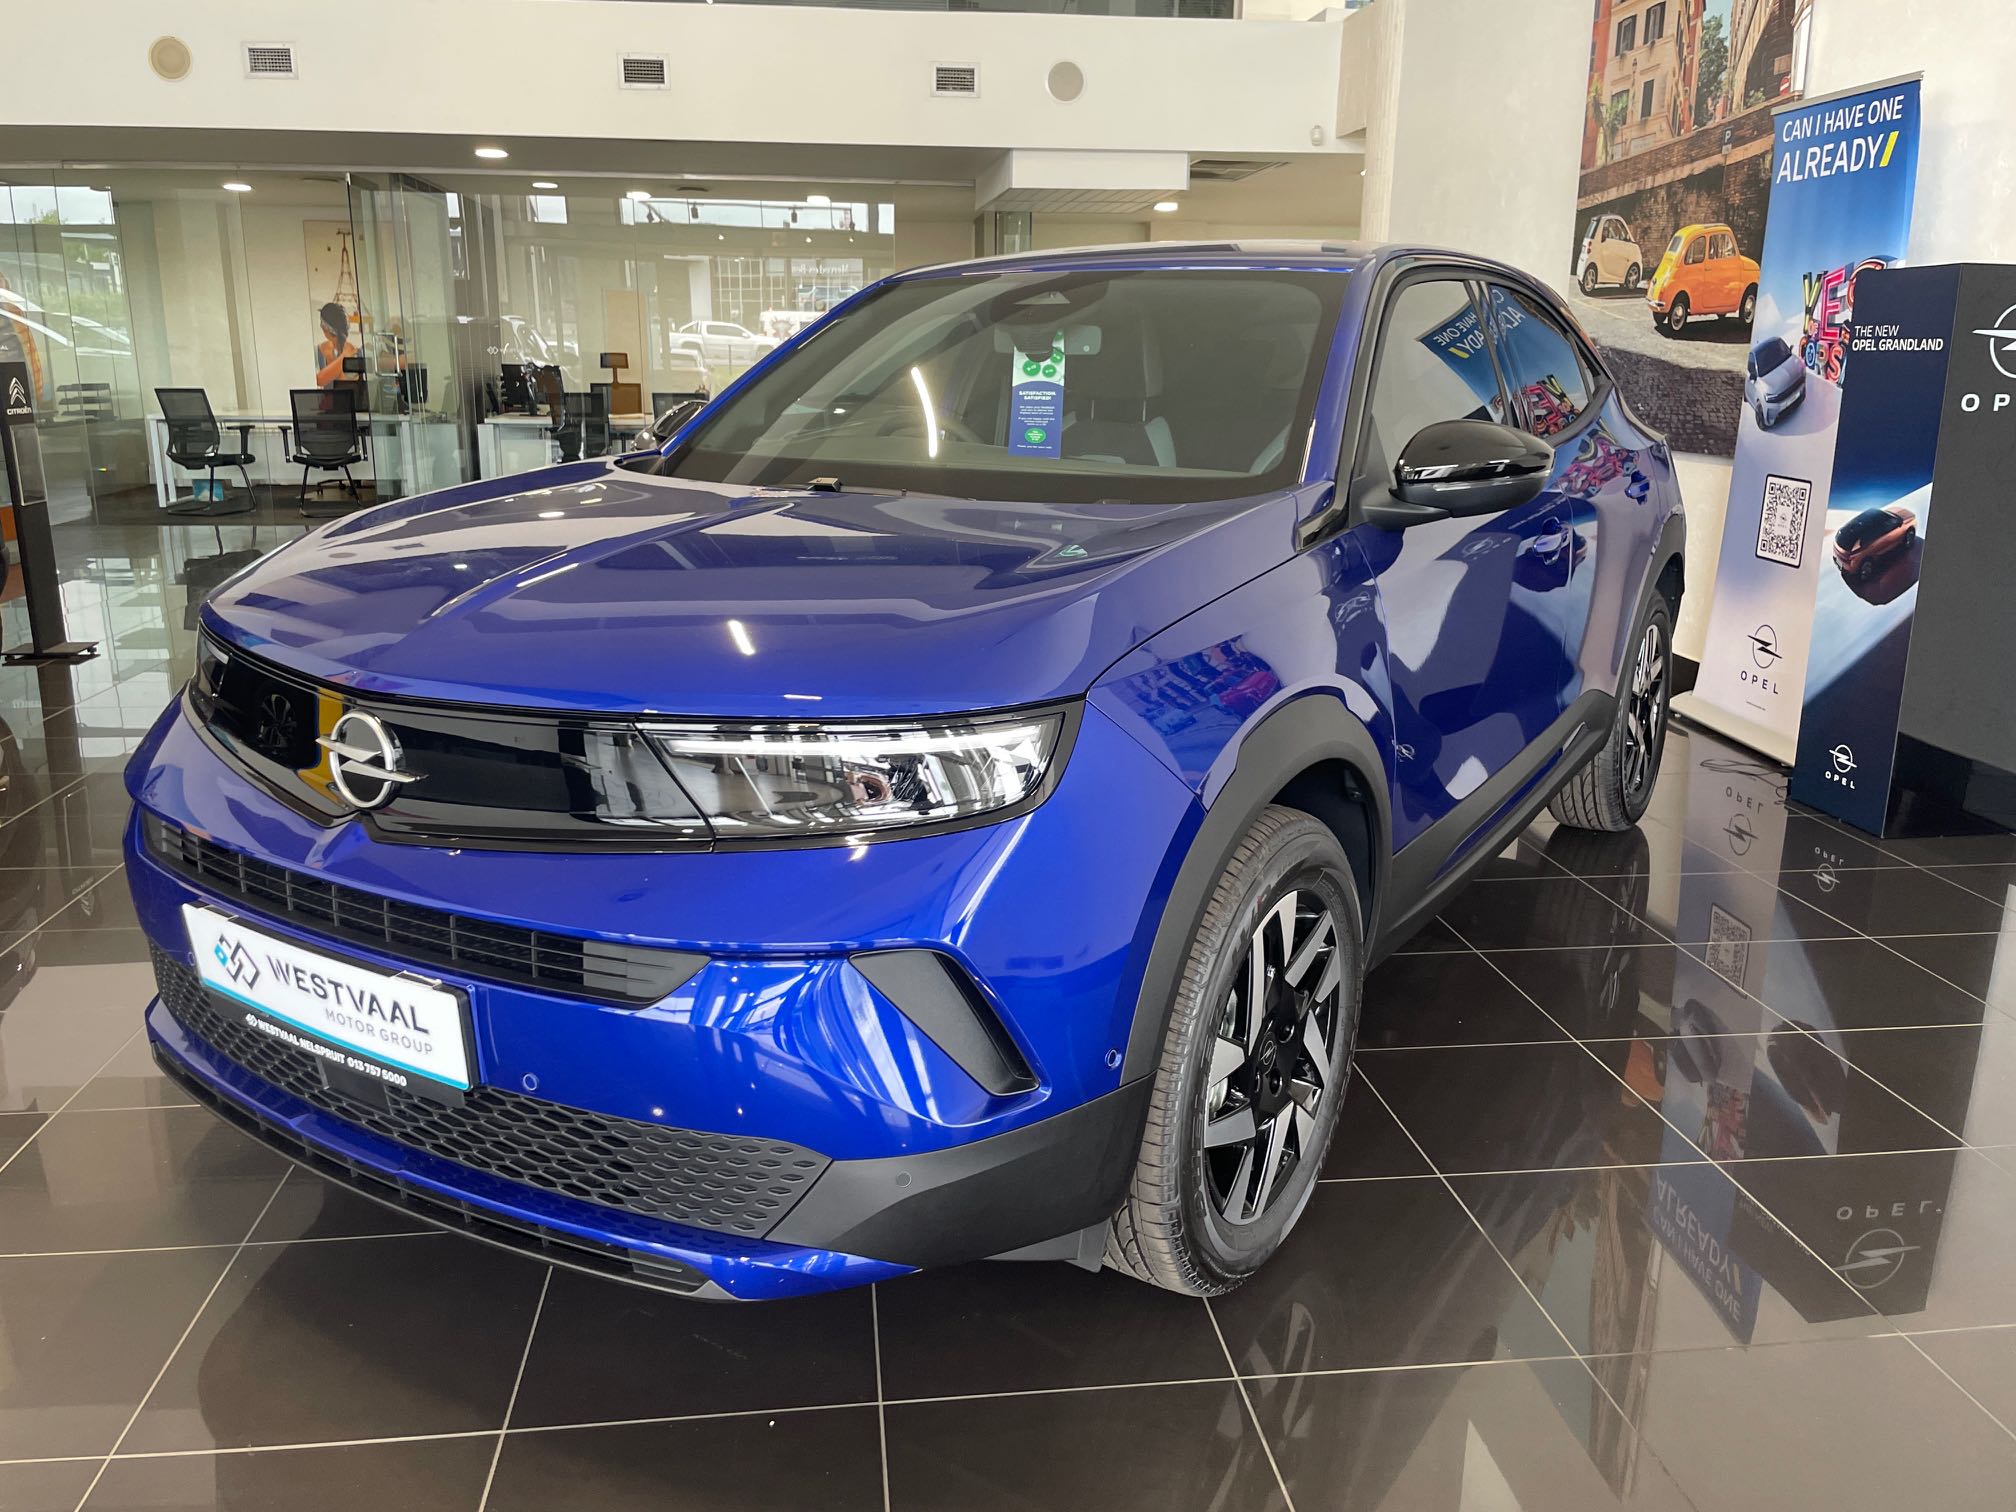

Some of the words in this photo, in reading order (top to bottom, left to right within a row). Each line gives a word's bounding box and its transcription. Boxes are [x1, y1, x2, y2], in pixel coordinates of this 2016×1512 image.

[1782, 115, 1812, 143] CAN
[1815, 114, 1822, 136] I
[1823, 105, 1865, 135] HAVE
[1868, 95, 1905, 124] ONE
[1852, 339, 1877, 351] OPEL
[1878, 338, 1944, 351] GRANDLAND
[1854, 326, 1873, 337] THE
[1875, 325, 1899, 337] NEW
[1740, 670, 1779, 695] OPEL
[1825, 771, 1856, 789] OPEL
[266, 954, 431, 1035] WESTVAAL
[325, 1008, 375, 1037] MOTOR
[380, 1028, 433, 1055] GROUP
[257, 1019, 299, 1046] WESTVAAL
[299, 1038, 346, 1064] NELSPRUIT
[347, 1056, 365, 1071] 013
[365, 1062, 381, 1077] 757
[381, 1068, 408, 1087] 5000
